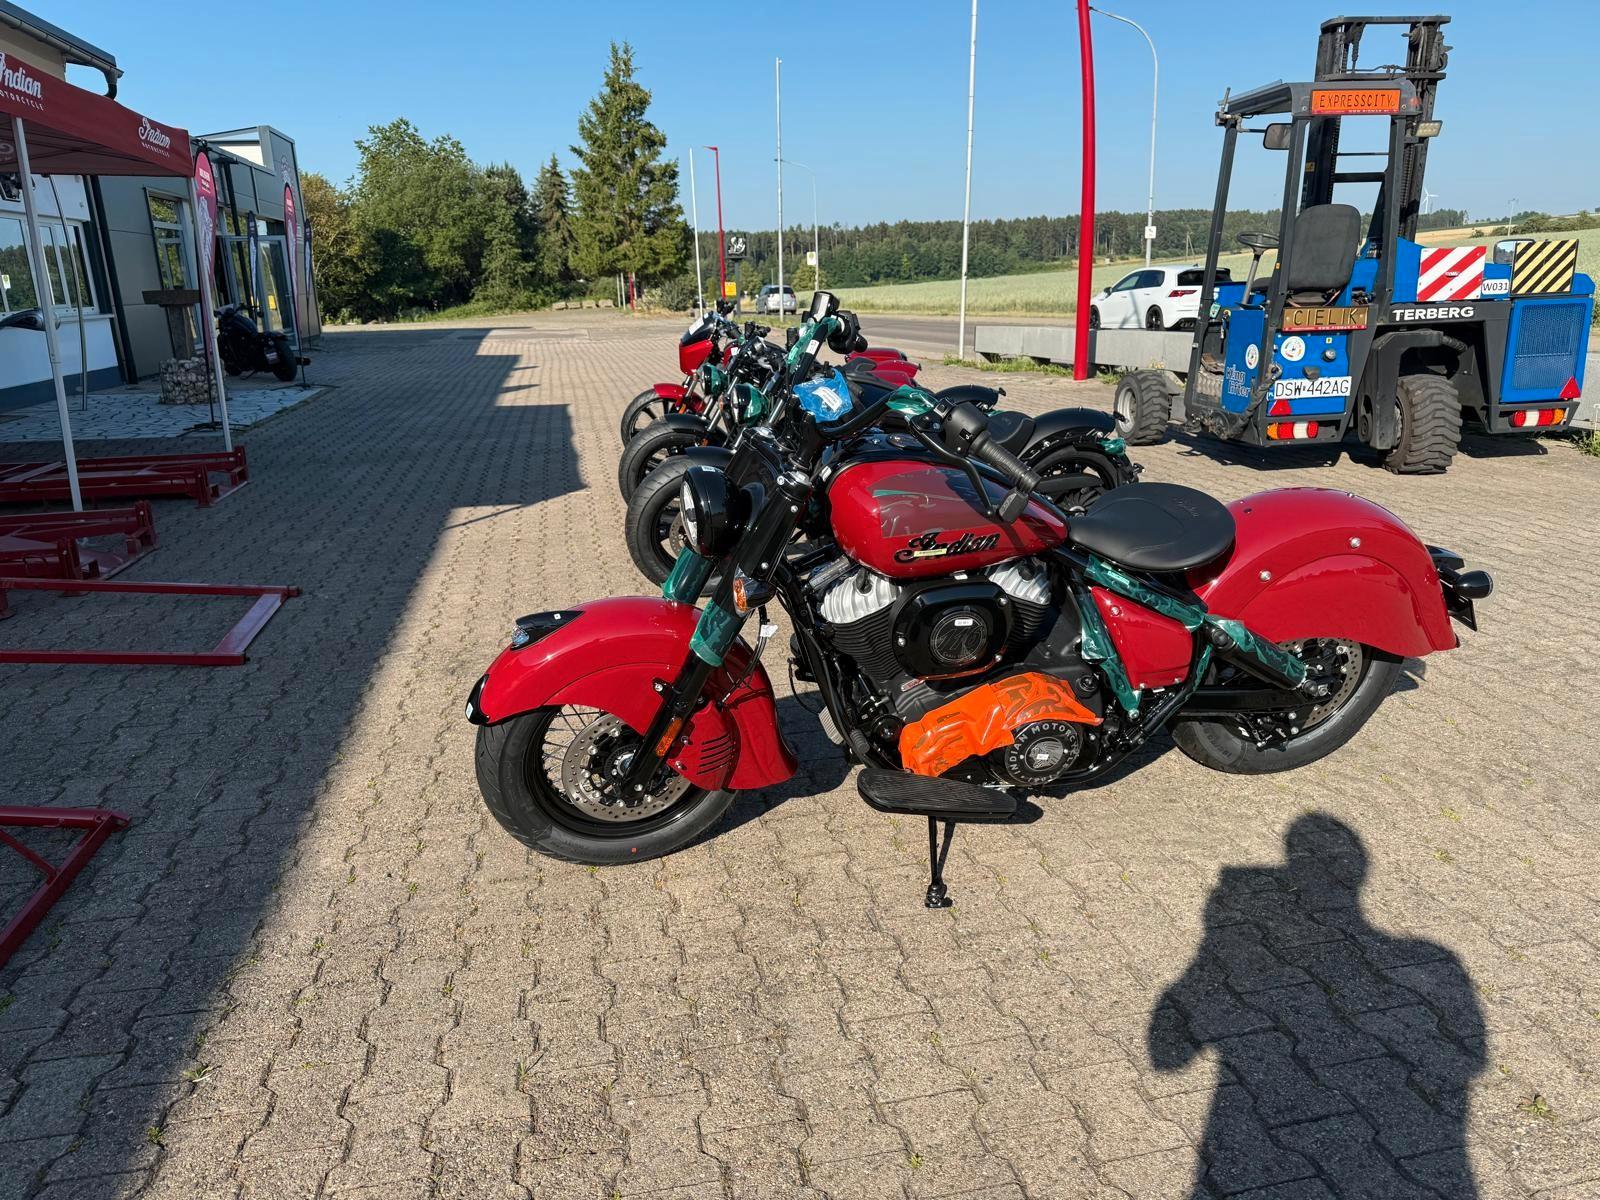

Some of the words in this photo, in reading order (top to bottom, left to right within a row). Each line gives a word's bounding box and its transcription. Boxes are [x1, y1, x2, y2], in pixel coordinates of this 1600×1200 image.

[1319, 94, 1394, 108] EXPRESSCITY
[139, 116, 170, 148] Indian
[1482, 282, 1509, 292] W031
[1293, 308, 1358, 326] CIELIK
[1392, 306, 1475, 321] TERBERG
[1275, 382, 1304, 397] DSW
[1307, 379, 1349, 396] 442AG
